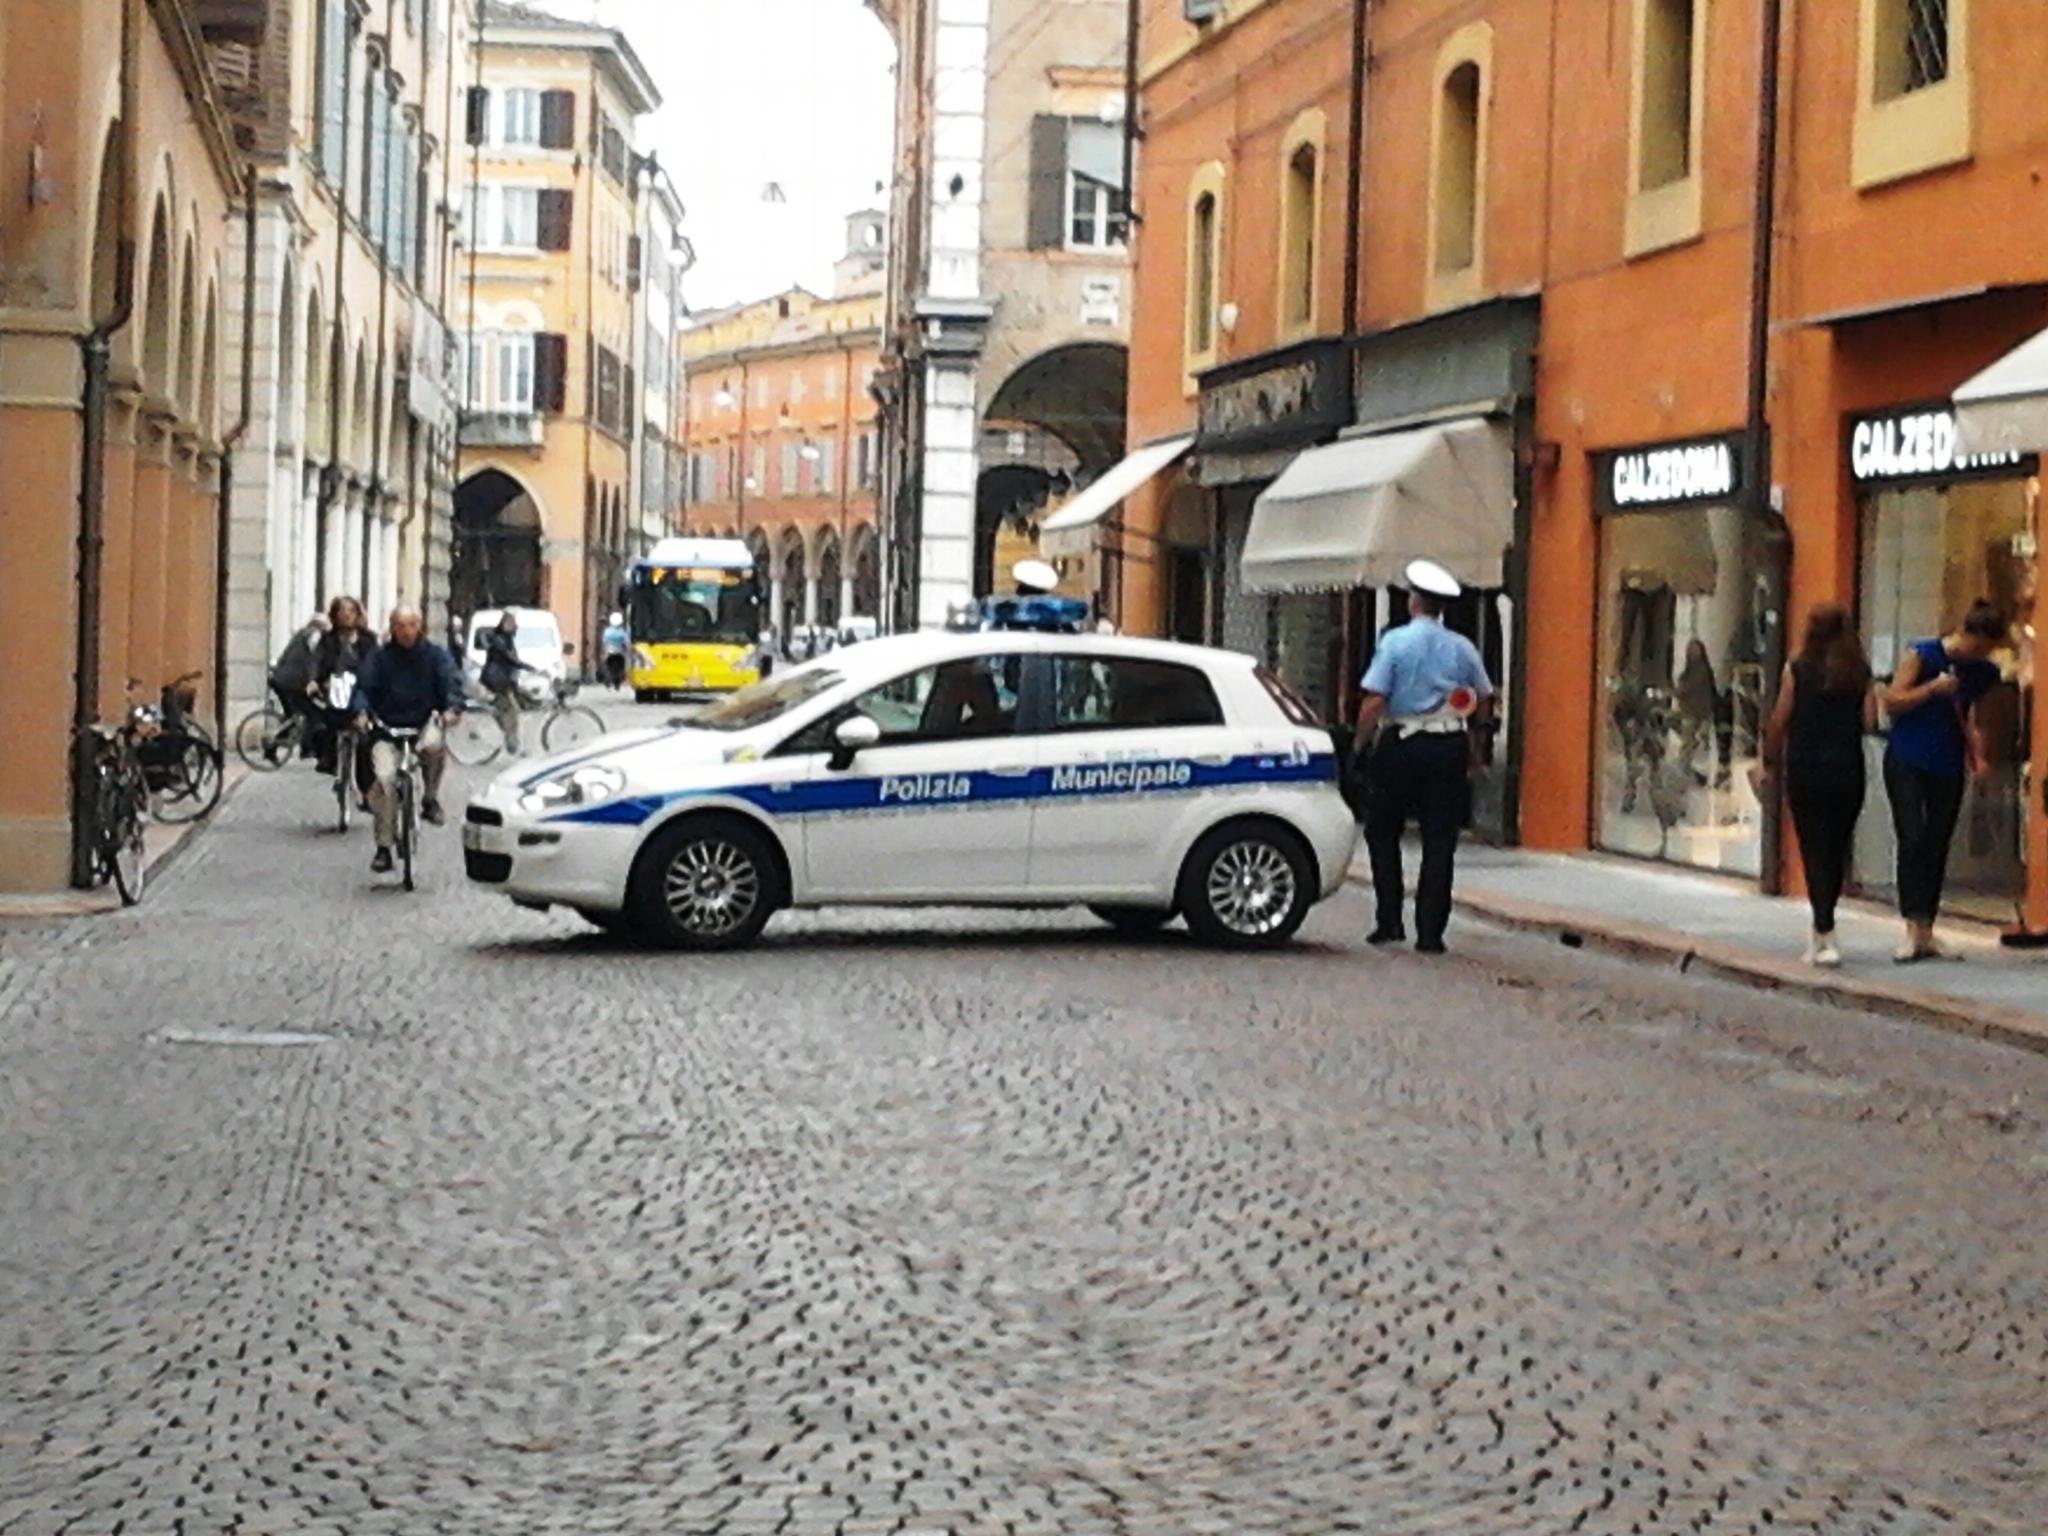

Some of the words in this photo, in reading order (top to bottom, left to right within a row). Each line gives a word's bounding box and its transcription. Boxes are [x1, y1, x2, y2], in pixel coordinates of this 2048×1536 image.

[1853, 412, 2019, 478] CALZED
[879, 775, 972, 802] Polizia
[1052, 759, 1191, 793] Municipale
